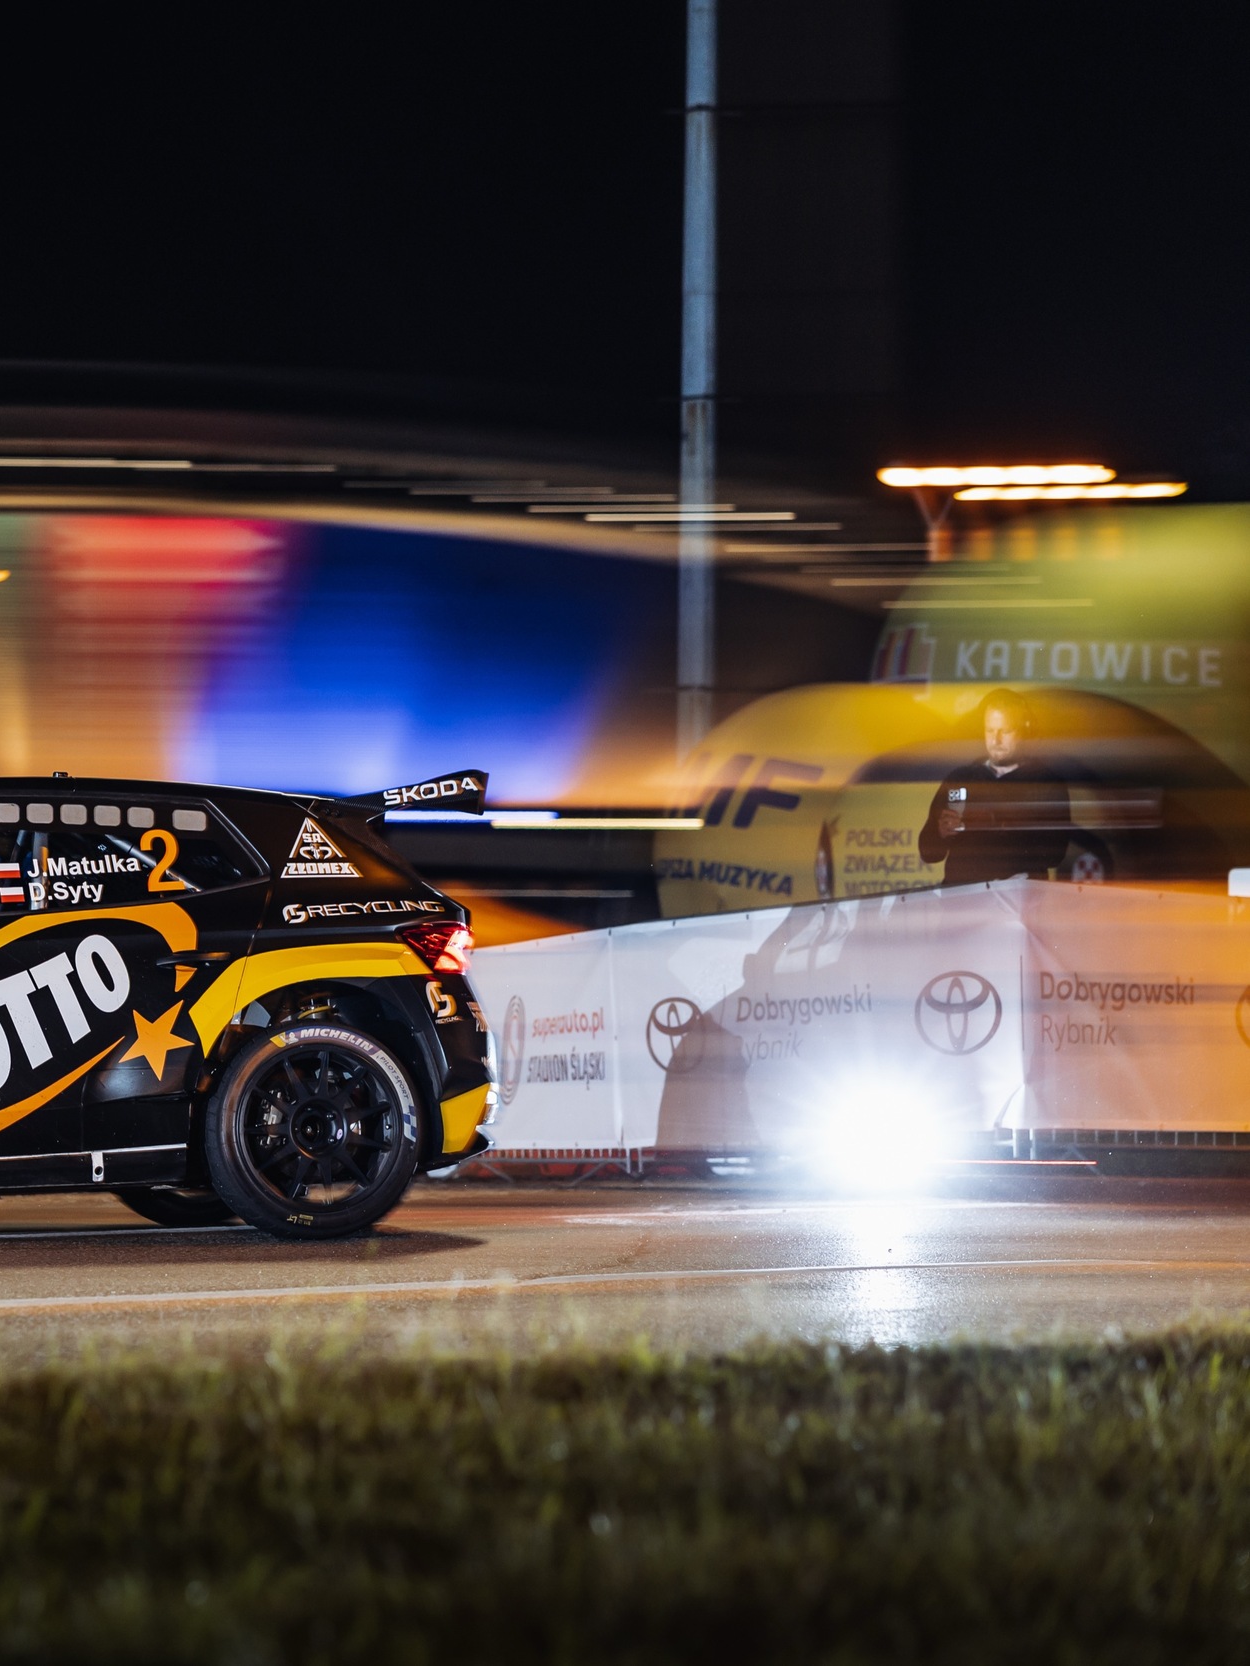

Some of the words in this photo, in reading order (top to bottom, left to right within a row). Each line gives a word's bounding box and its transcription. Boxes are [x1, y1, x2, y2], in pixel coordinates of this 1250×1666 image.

[954, 638, 1223, 687] KATOWICE
[845, 828, 913, 848] POLSKI
[27, 854, 141, 878] J.Matulka
[140, 829, 186, 892] 2
[698, 860, 793, 896] MUZYKA
[28, 881, 104, 904] D.Syty
[736, 983, 873, 1025] Dobrygowski
[1039, 971, 1195, 1012] Dobrygowski
[300, 1028, 374, 1052] MICHELIN
[531, 1007, 605, 1042] superauto.pl
[1040, 1014, 1117, 1051] Rybnik
[744, 1030, 805, 1067] ybnik
[379, 1056, 397, 1075] PILOT
[394, 1075, 410, 1100] SPORT
[527, 1054, 568, 1083] STADION
[570, 1046, 606, 1091] ŚLĄSKI
